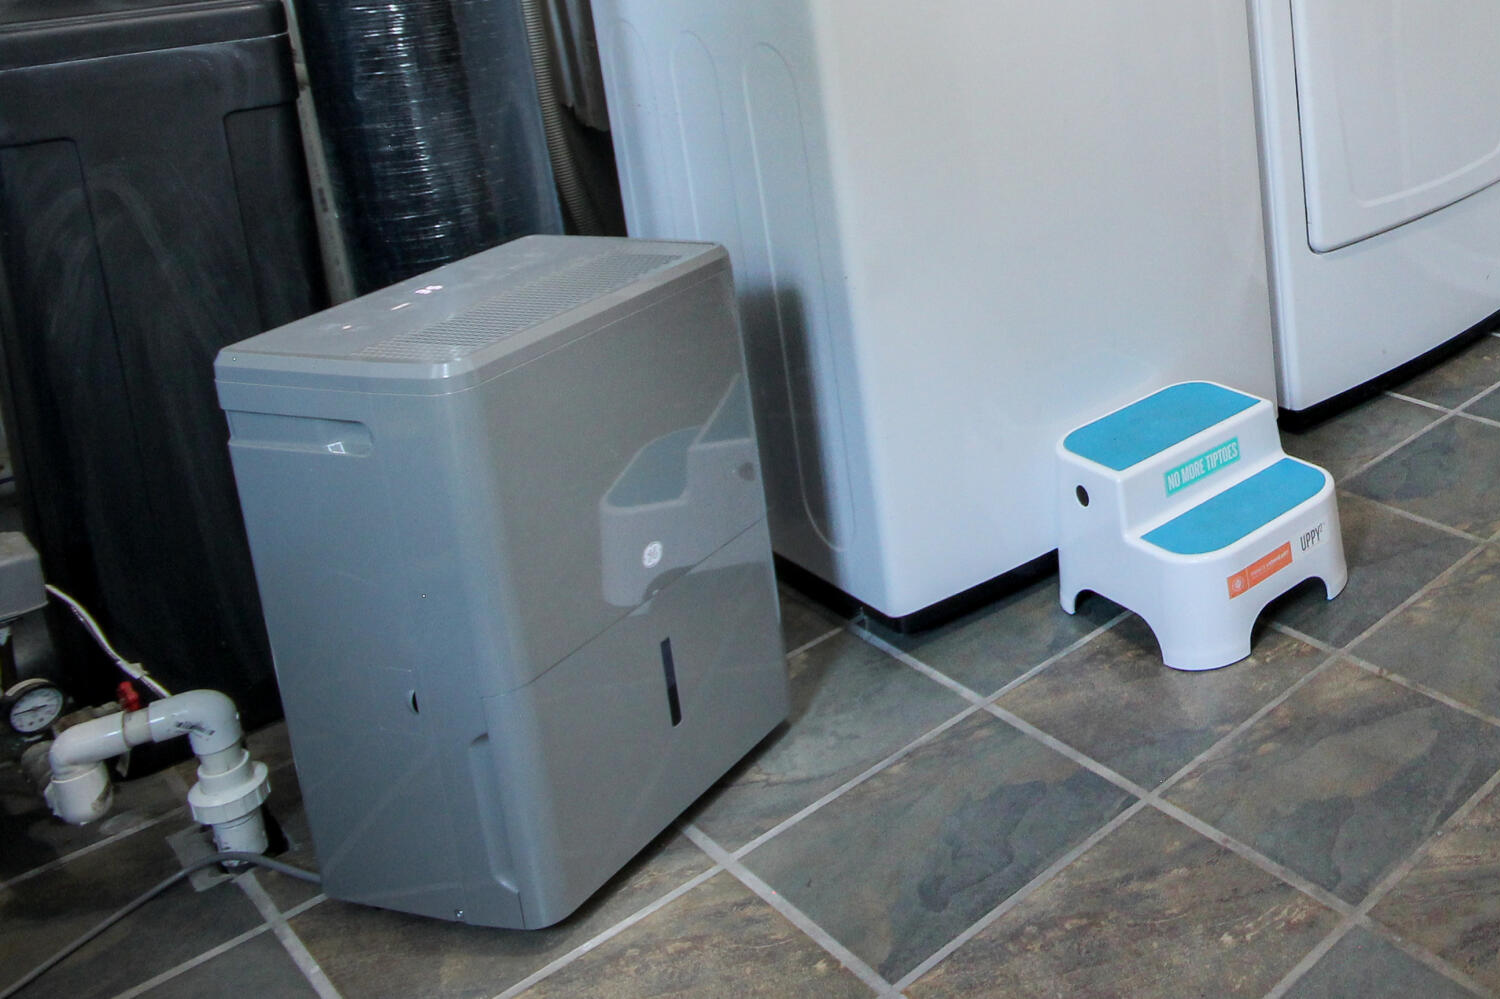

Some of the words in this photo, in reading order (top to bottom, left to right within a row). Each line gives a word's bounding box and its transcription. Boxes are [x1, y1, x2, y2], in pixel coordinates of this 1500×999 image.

[1168, 471, 1180, 491] NO
[1181, 458, 1205, 484] MORE
[1206, 442, 1238, 470] TIPTOES
